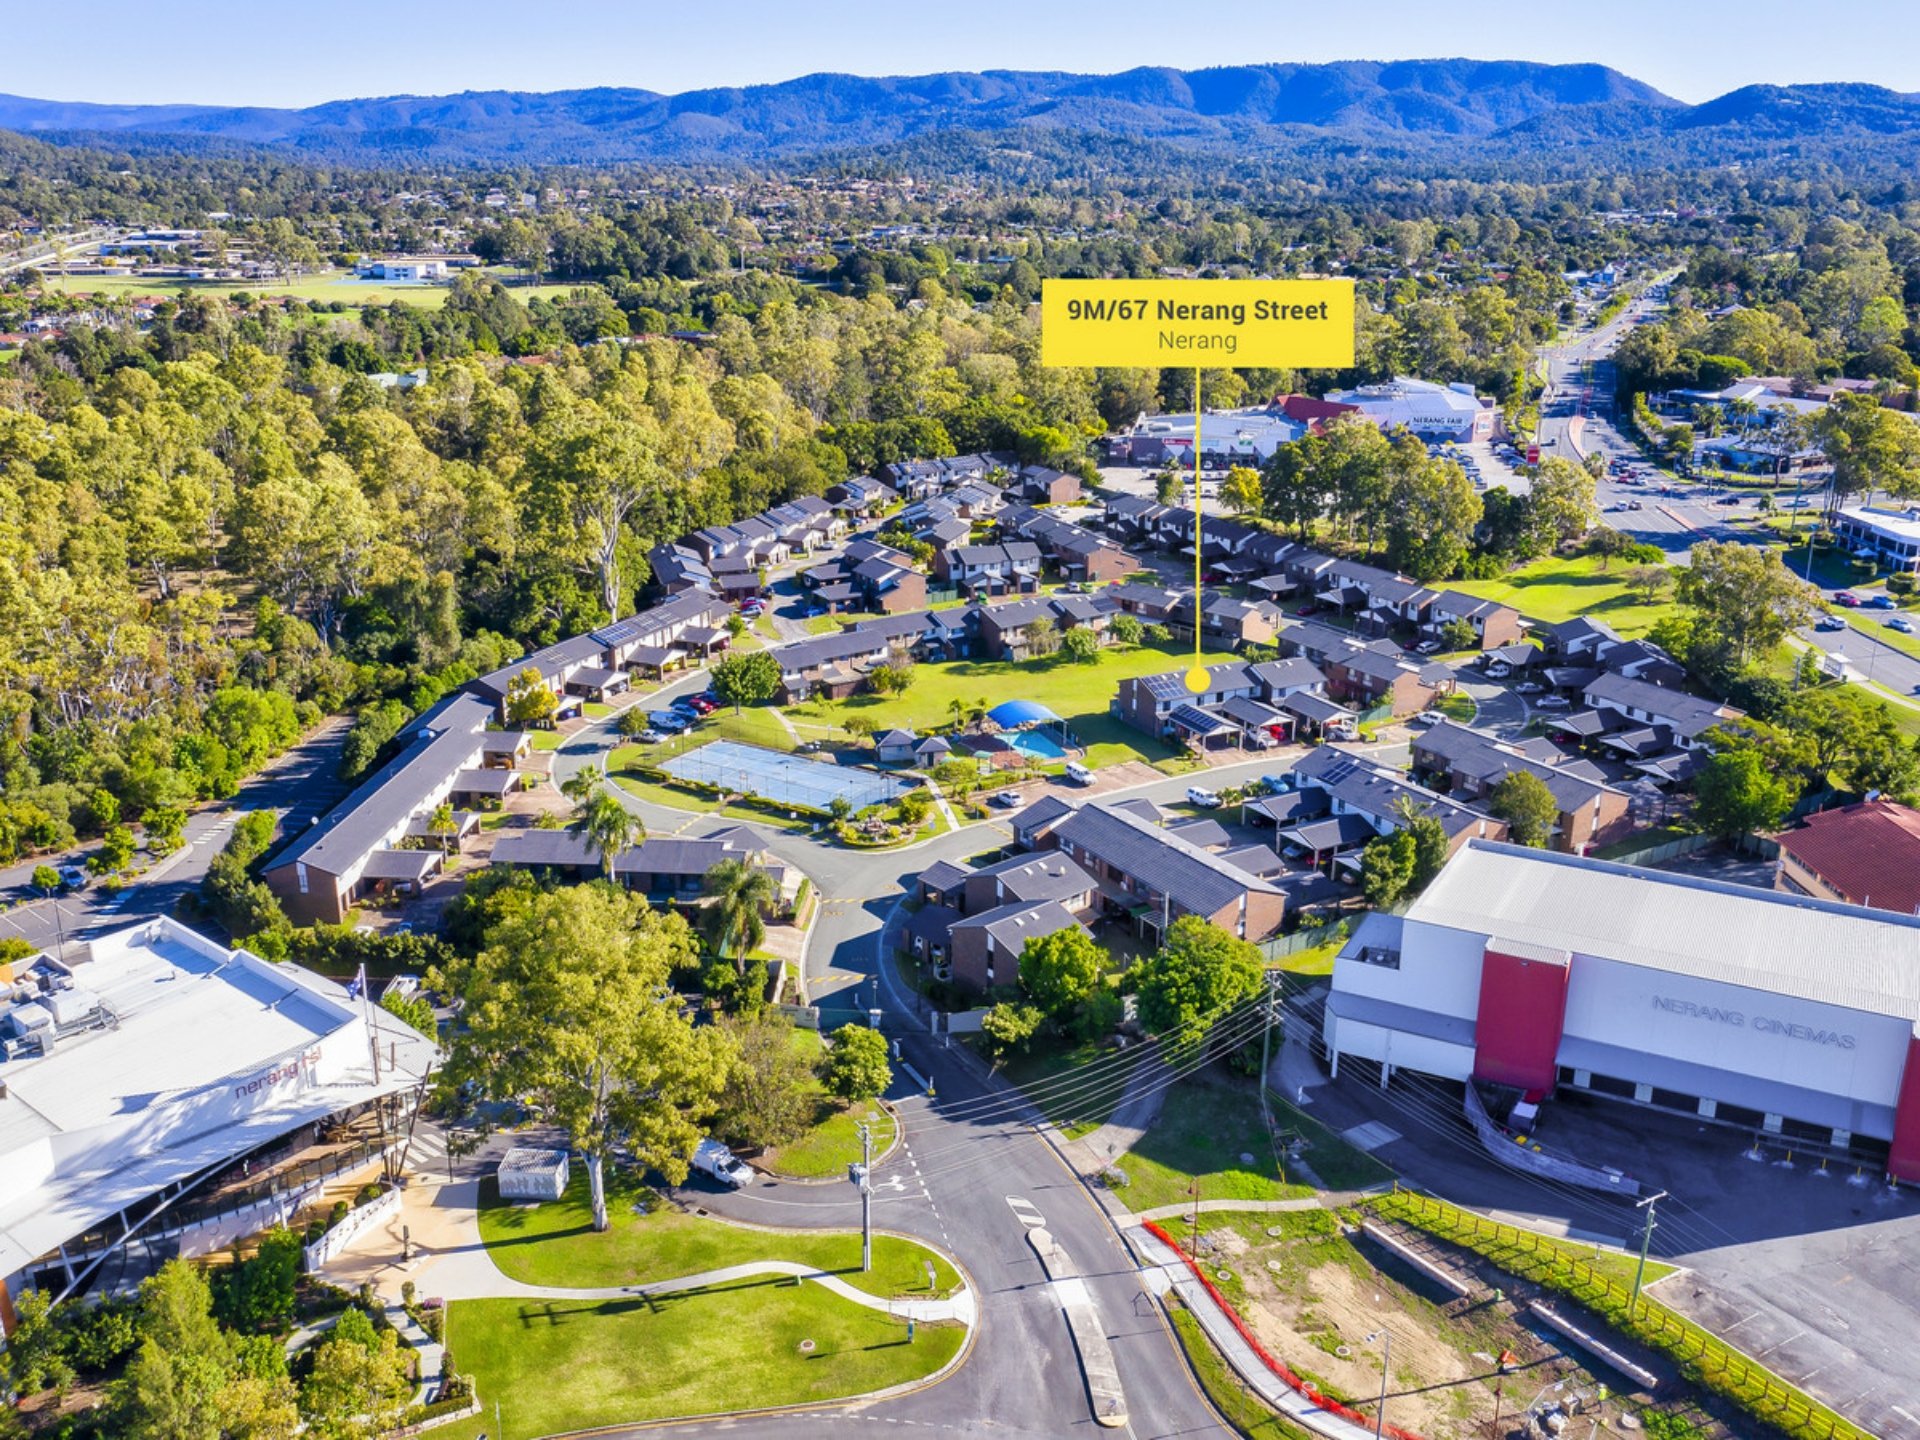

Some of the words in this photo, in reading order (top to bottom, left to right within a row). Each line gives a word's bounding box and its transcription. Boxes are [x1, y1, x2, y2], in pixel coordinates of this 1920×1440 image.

[1447, 417, 1463, 425] FAIR
[1653, 995, 1745, 1026] NERANG
[1753, 1016, 1855, 1050] CINEMAS
[235, 1061, 299, 1098] nerang
[302, 1046, 322, 1068] rsl
